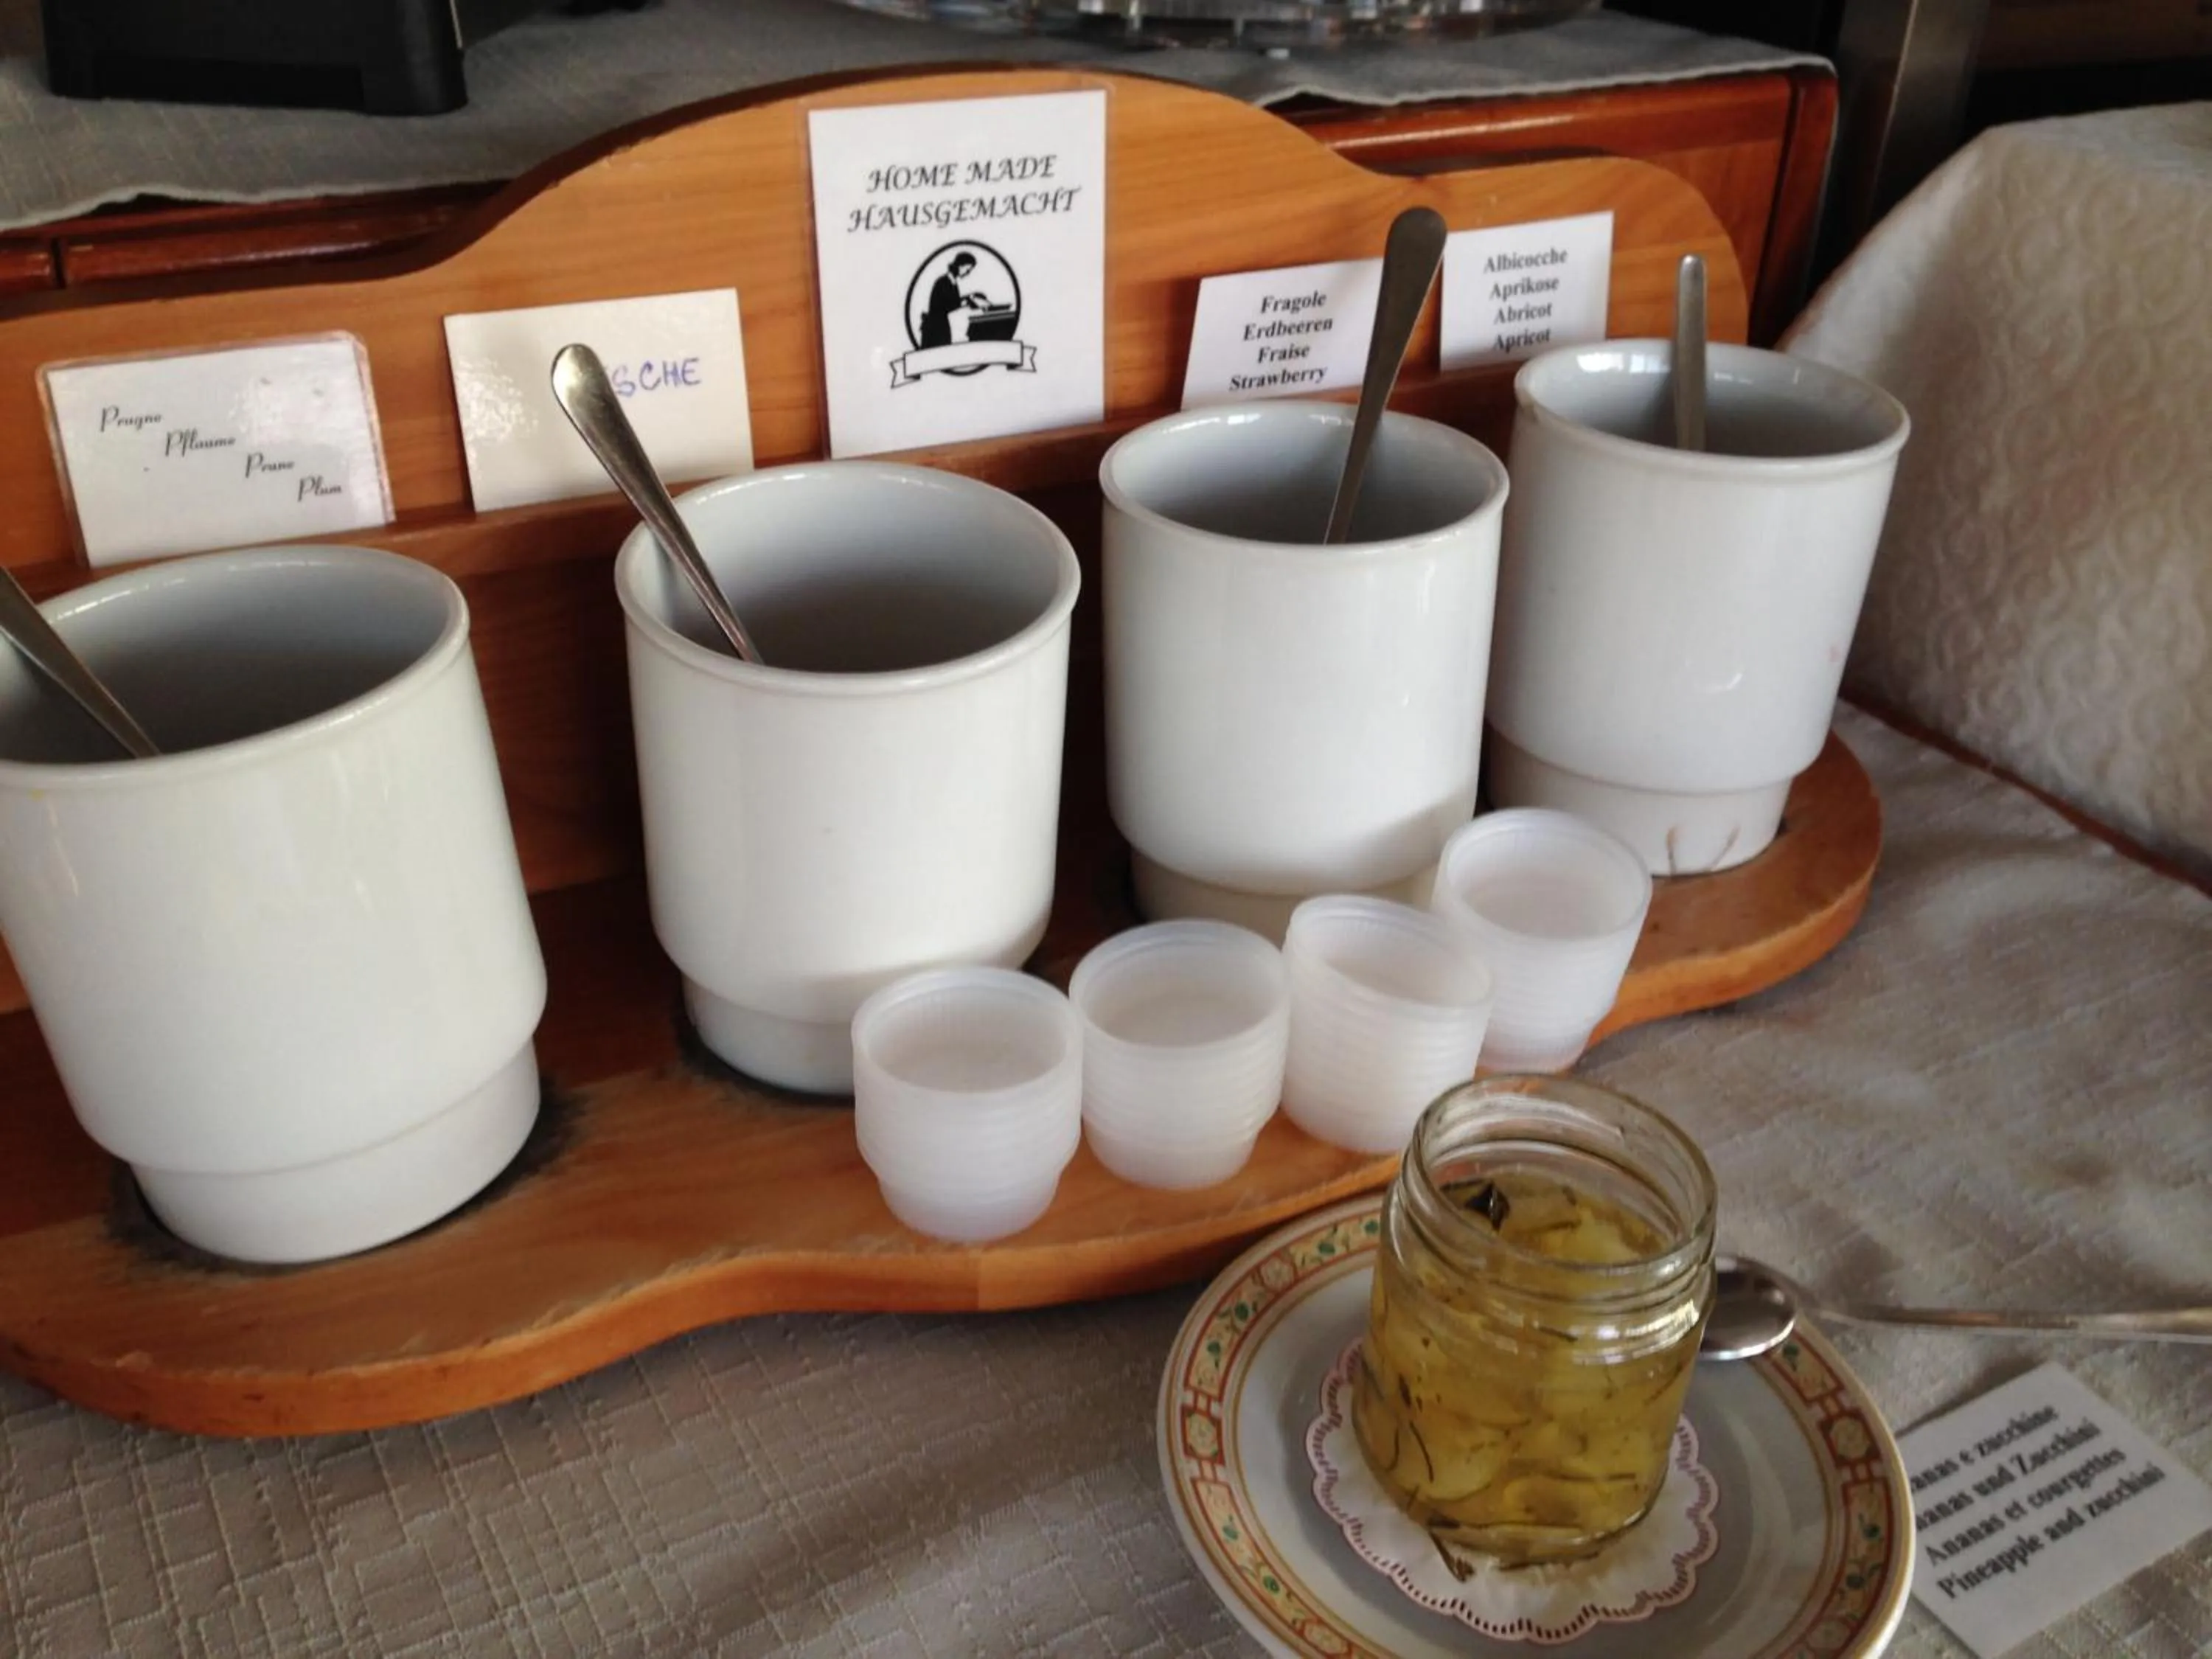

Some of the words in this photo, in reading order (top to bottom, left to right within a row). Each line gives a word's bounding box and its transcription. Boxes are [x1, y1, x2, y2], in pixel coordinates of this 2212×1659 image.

[866, 163, 958, 194] HOME
[964, 154, 1058, 184] MADE
[846, 185, 1082, 233] HAUSGEMACHT
[1484, 248, 1568, 274] Albicocche
[1489, 276, 1559, 301] Aprikose
[1260, 291, 1327, 315] Fragole
[1493, 302, 1553, 324] Abricot
[1243, 316, 1333, 341] Erdbeeren
[1492, 328, 1551, 352] Apricot
[1256, 344, 1310, 364] Fraise
[611, 357, 701, 398] SCHE
[1229, 366, 1328, 392] Strawberry
[100, 404, 162, 432] Prugne
[164, 428, 236, 456] Pflaume
[245, 451, 295, 478] Prune
[296, 476, 342, 502] Plum
[1910, 1458, 1959, 1494] anas
[1972, 1463, 2017, 1497] und
[1924, 1513, 2006, 1567] Ananas
[2004, 1498, 2028, 1521] et
[2027, 1447, 2126, 1509] courgettes
[1936, 1533, 2045, 1599] Pineapple
[2043, 1507, 2086, 1540] and
